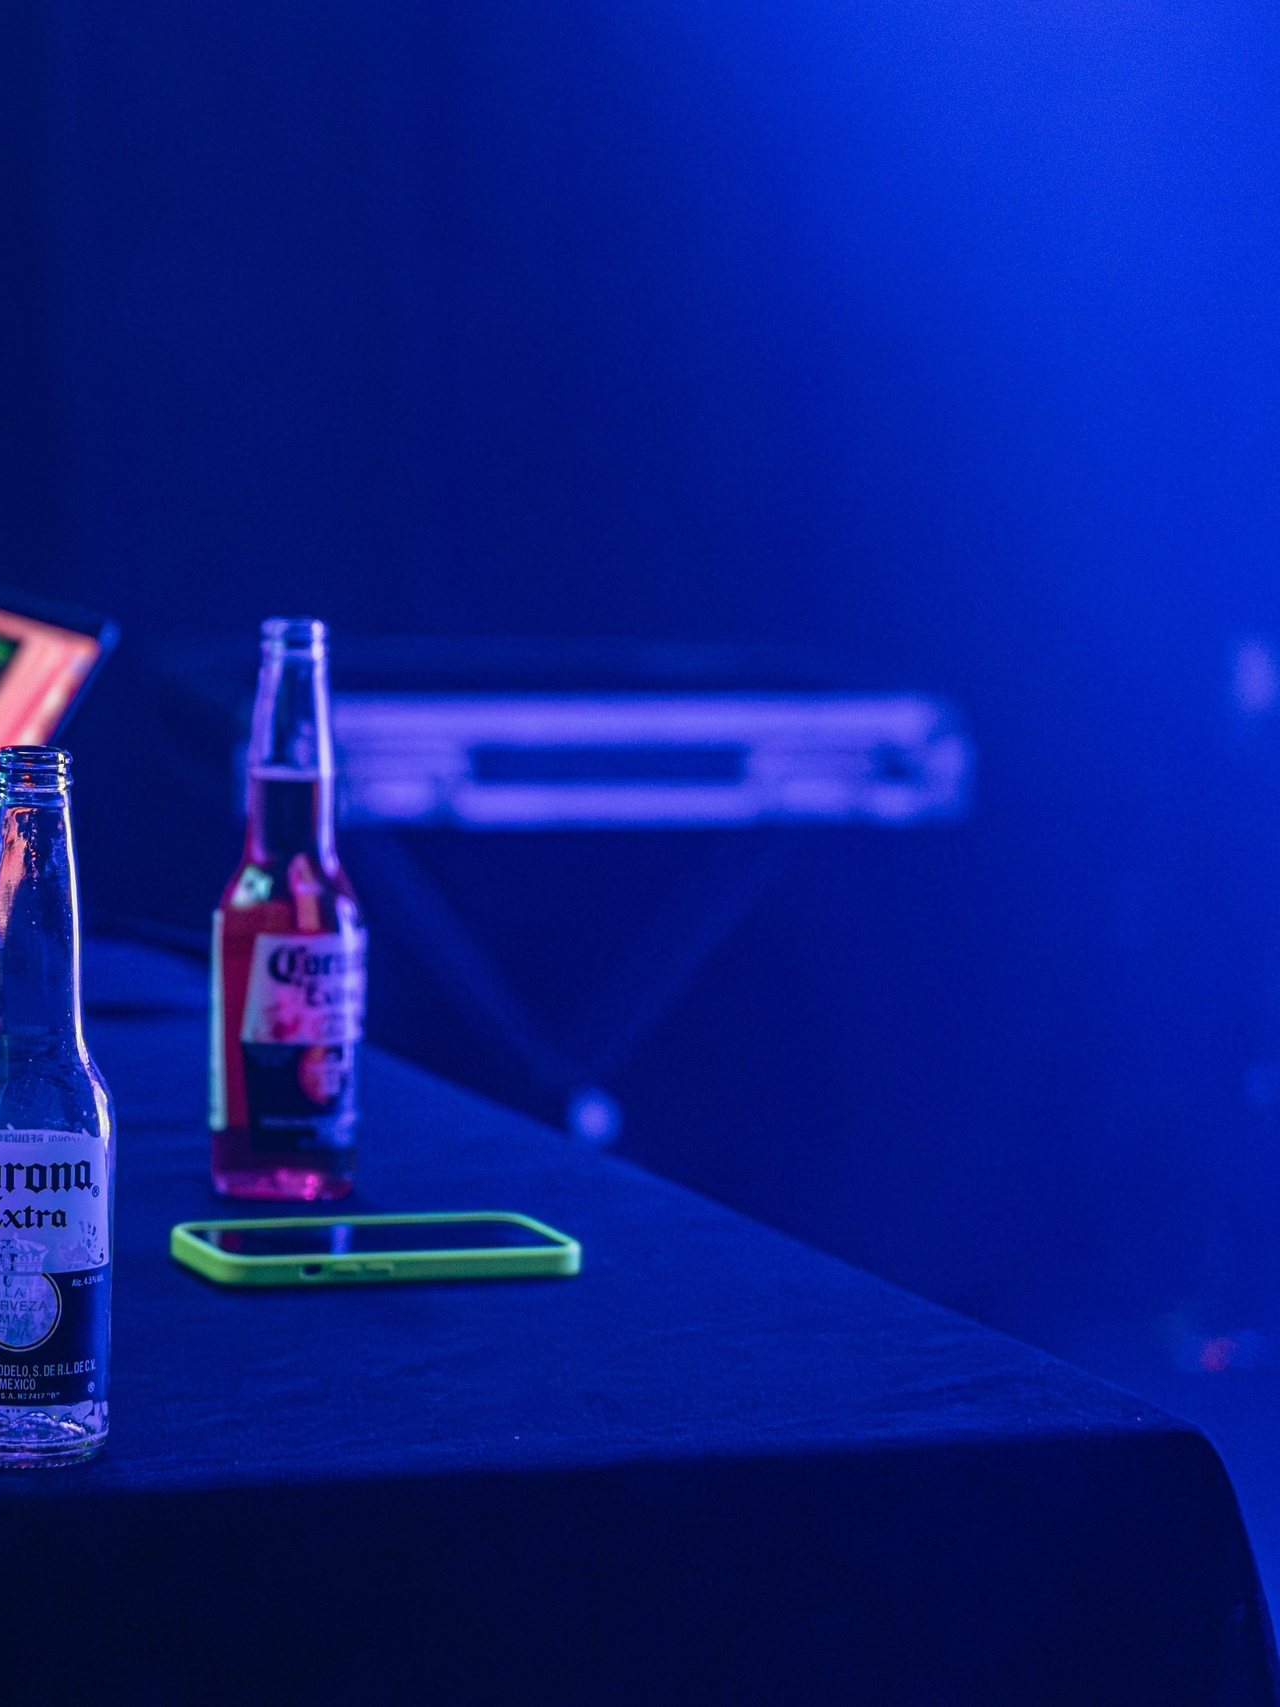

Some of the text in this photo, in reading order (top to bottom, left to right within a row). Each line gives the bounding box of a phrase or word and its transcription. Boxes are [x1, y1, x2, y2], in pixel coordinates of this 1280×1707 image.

[5, 1287, 24, 1298] LA
[43, 1364, 56, 1377] DE
[73, 1360, 85, 1374] DE
[0, 1378, 36, 1391] MEXICO
[28, 1392, 45, 1400] 7417
